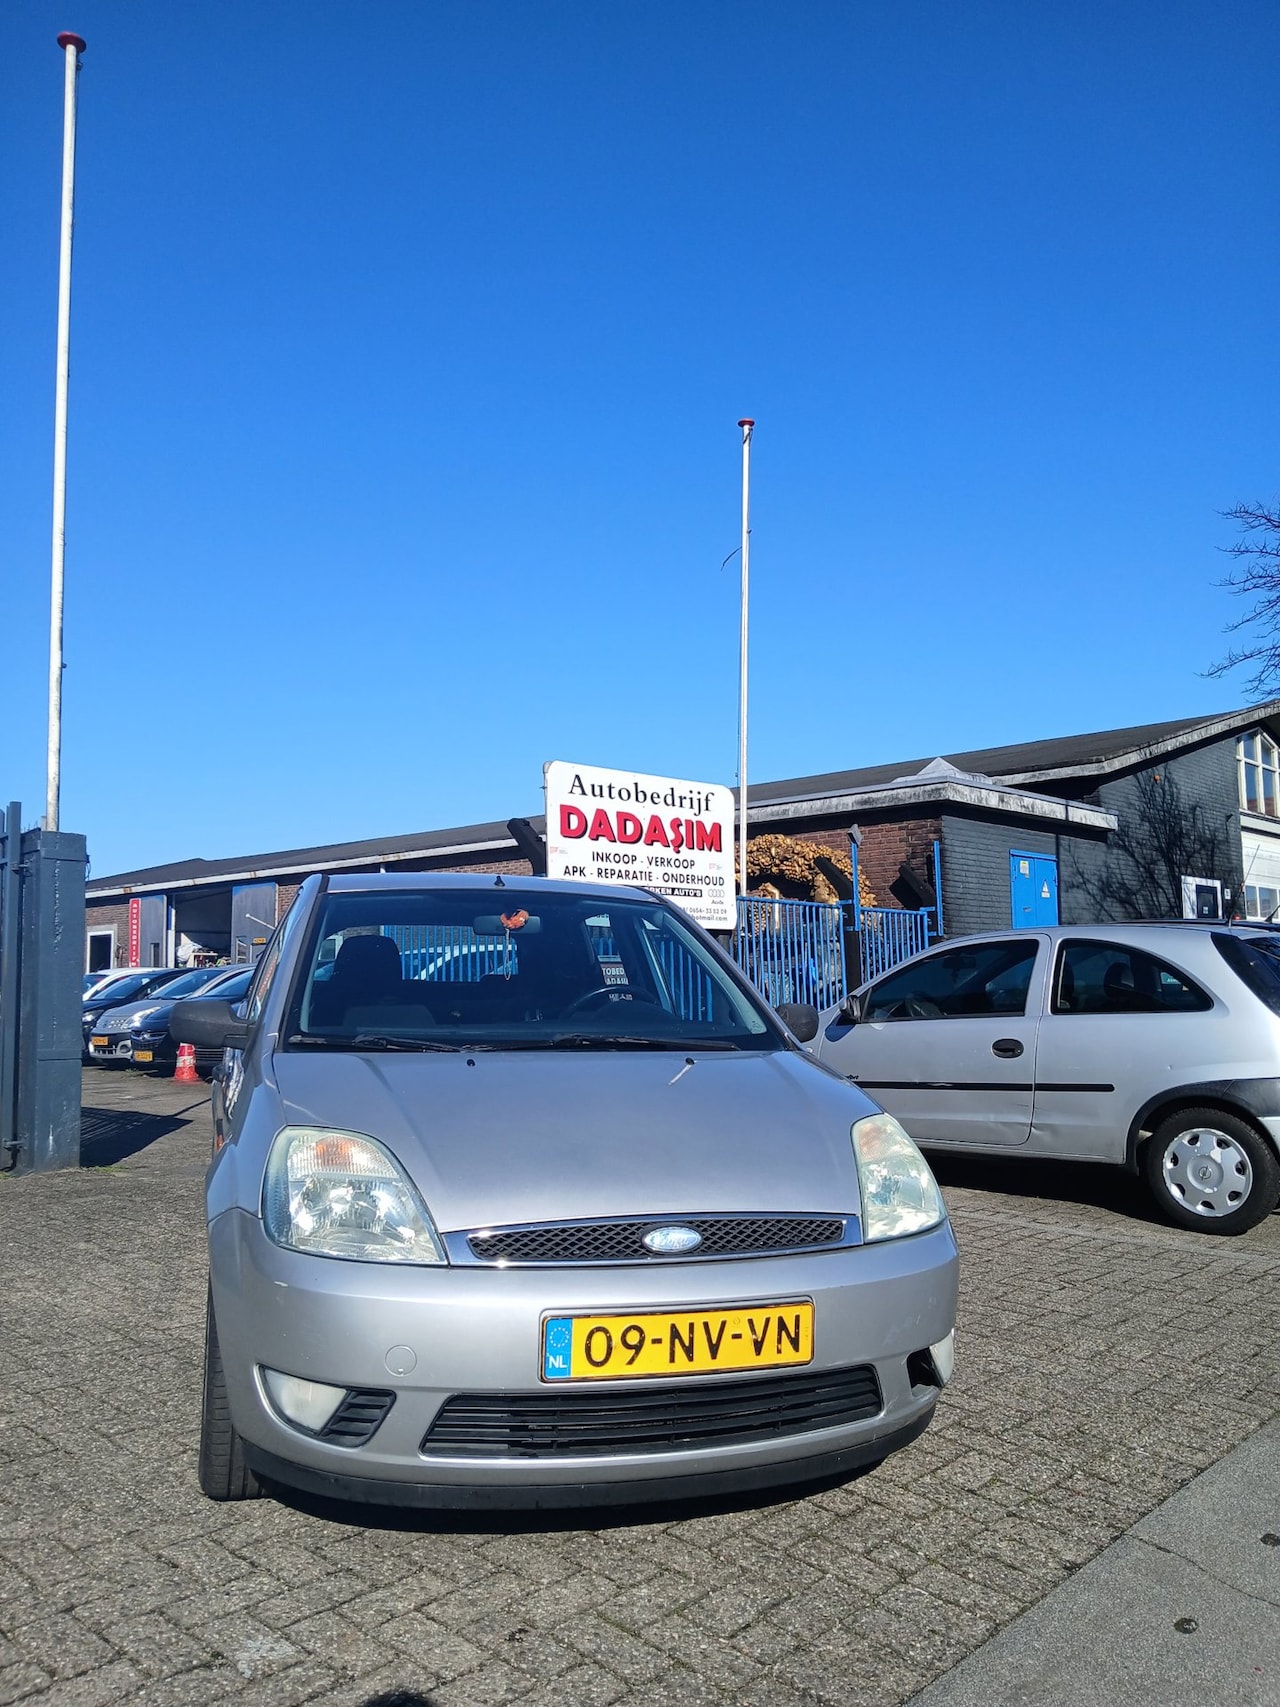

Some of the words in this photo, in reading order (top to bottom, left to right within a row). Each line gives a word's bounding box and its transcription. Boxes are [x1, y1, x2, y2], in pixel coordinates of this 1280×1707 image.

[568, 774, 714, 816] Autobedrijf
[559, 804, 722, 853] DADAŞIM
[592, 851, 637, 865] INKOOP
[647, 856, 695, 869] VERKOOP
[563, 865, 586, 877] APK
[597, 868, 652, 882] REPARATIE
[662, 873, 725, 886] ONDERHOUD
[673, 888, 701, 897] AUTO'S
[585, 1314, 800, 1368] 09-NV-VN
[549, 1353, 567, 1369] NL
